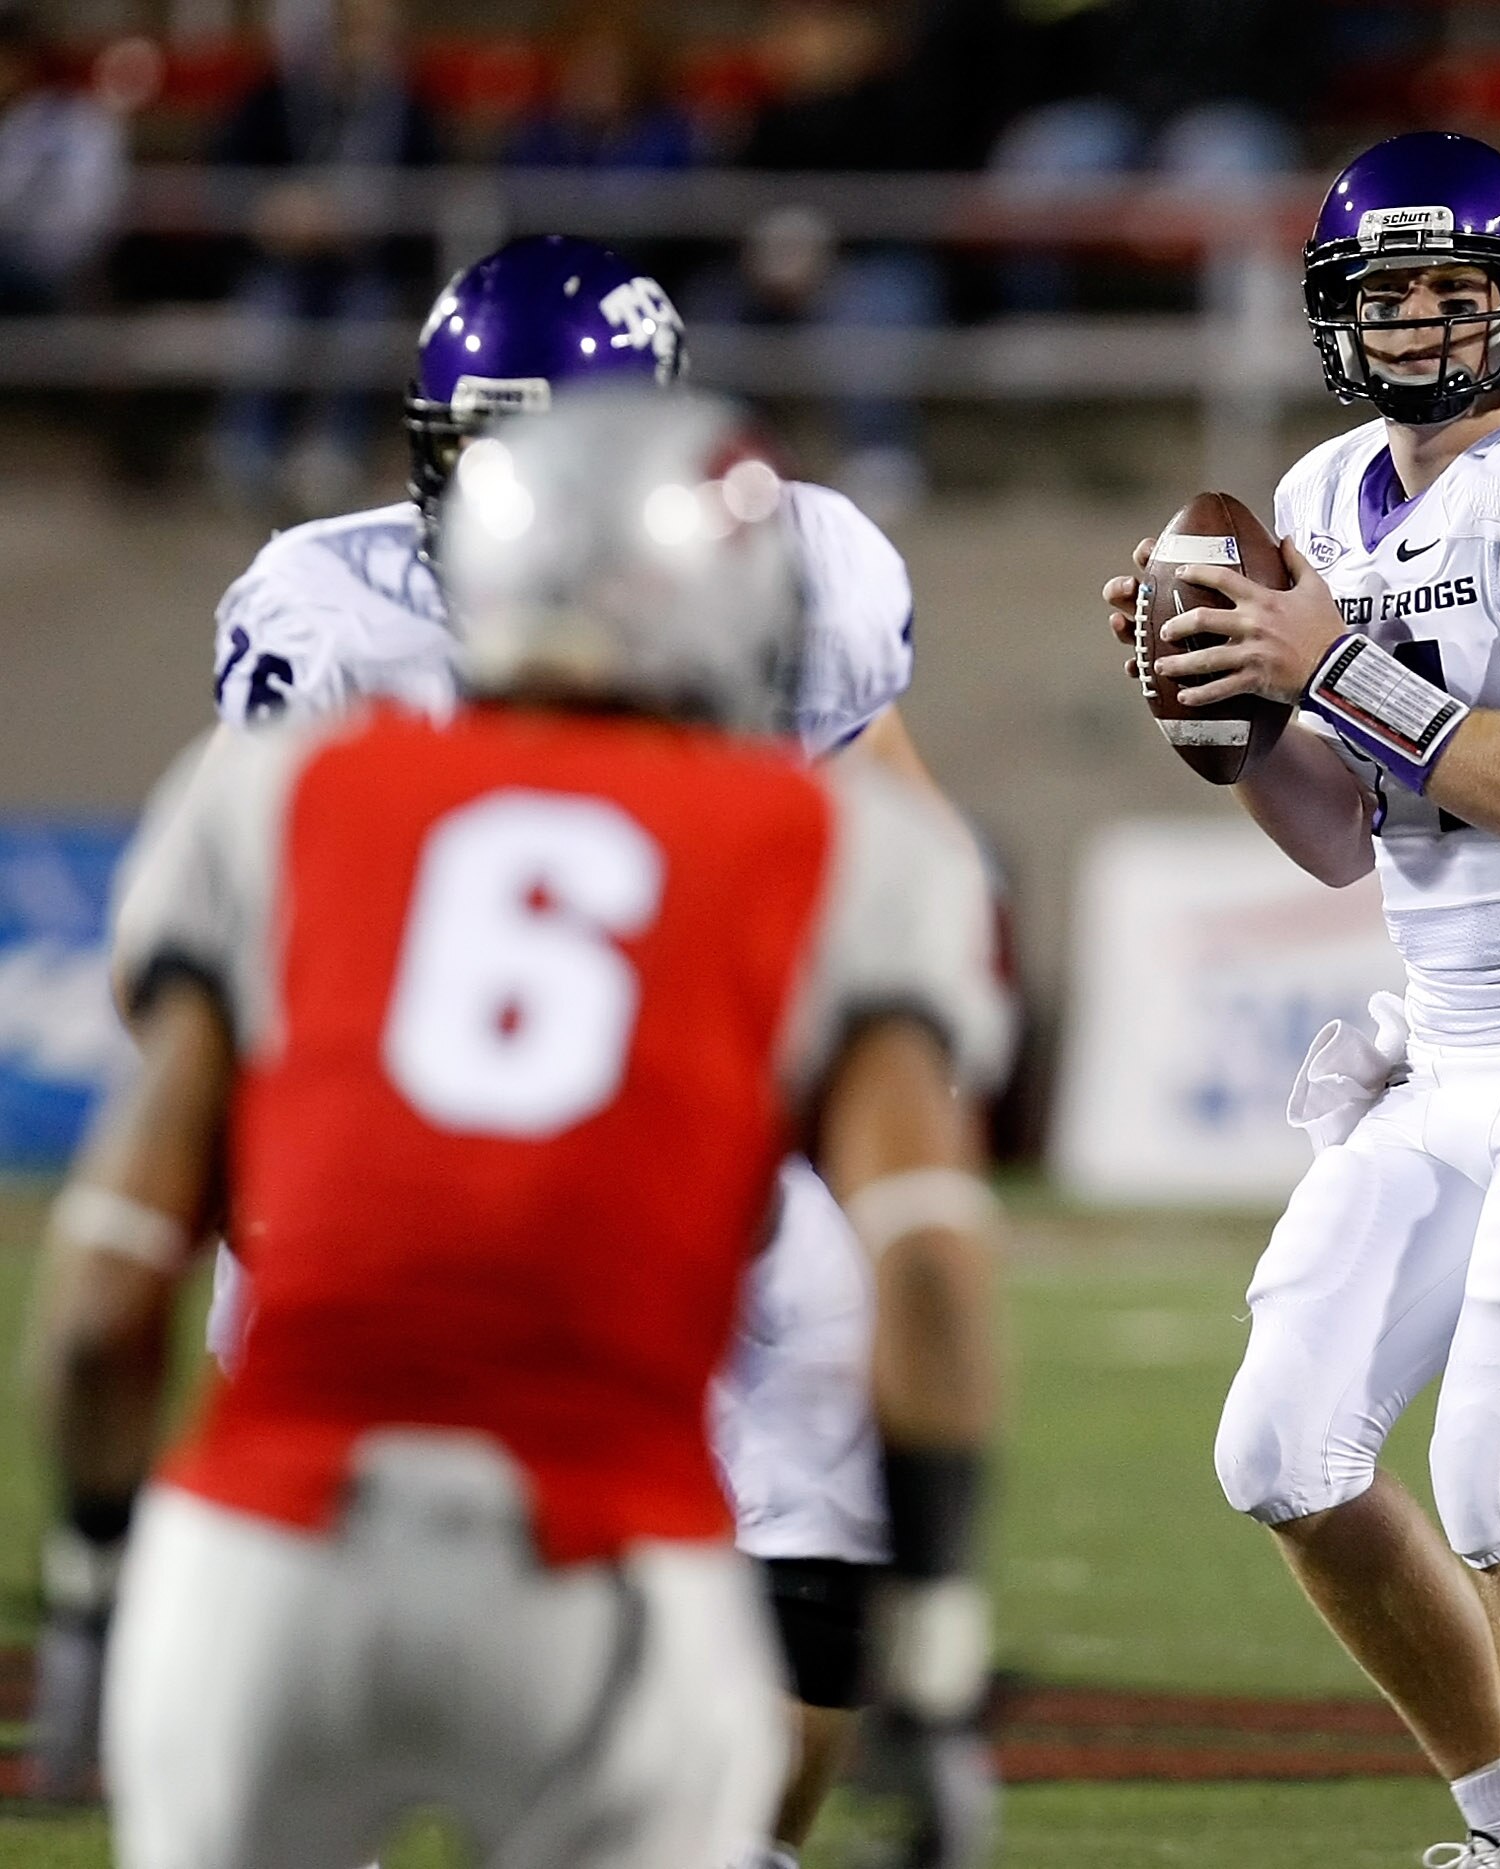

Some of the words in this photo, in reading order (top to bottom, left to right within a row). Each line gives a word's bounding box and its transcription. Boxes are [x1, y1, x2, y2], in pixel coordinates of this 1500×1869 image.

[1382, 210, 1431, 225] schutt
[1380, 576, 1478, 620] FROGS
[380, 786, 668, 1142] 6
